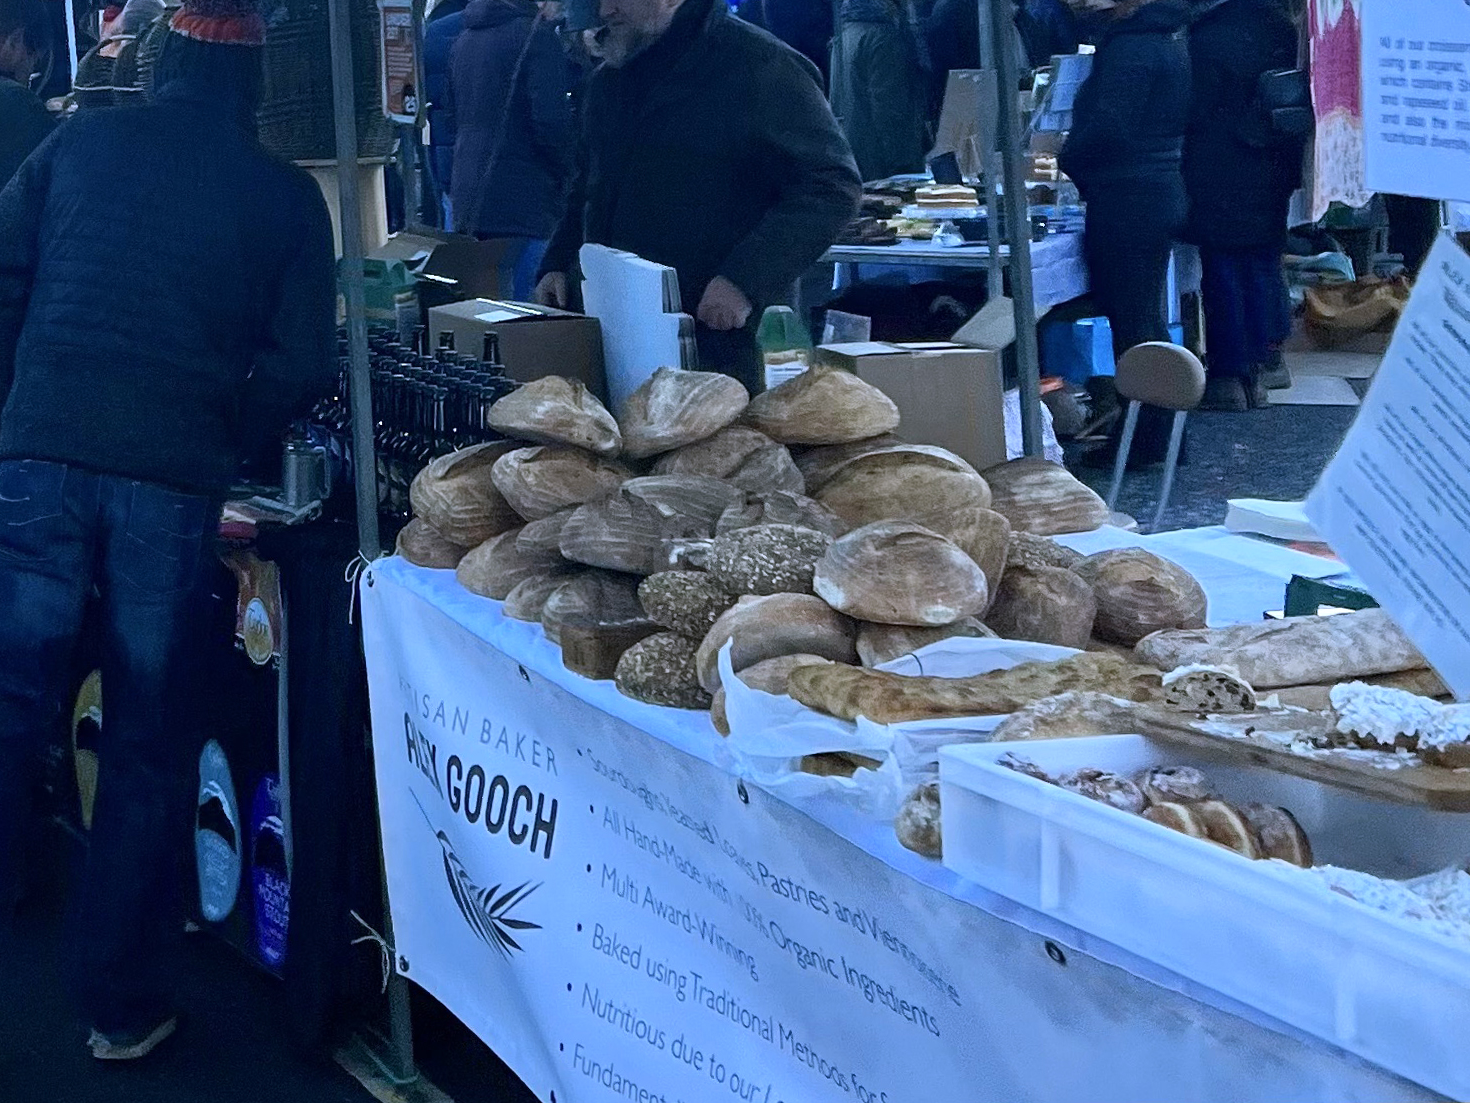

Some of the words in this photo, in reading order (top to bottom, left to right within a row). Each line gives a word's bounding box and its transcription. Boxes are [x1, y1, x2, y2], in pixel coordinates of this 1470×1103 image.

[447, 755, 558, 859] GOOCH
[480, 718, 558, 777] BAKER
[601, 863, 639, 904] Multi
[642, 886, 759, 982] Award-Winning
[603, 806, 621, 836] All
[624, 816, 702, 884] Hand-Made
[769, 920, 839, 980] Organic
[841, 955, 941, 1037] Ingredients
[757, 861, 830, 915] Pastries
[833, 900, 866, 935] and
[582, 982, 665, 1050] Nutritious
[671, 1033, 703, 1071] due
[709, 1053, 726, 1084] to
[730, 1072, 761, 1103] our
[592, 922, 642, 970] Baked
[646, 957, 687, 1002] using
[690, 971, 774, 1044] Traditional
[779, 1022, 849, 1092] Methods
